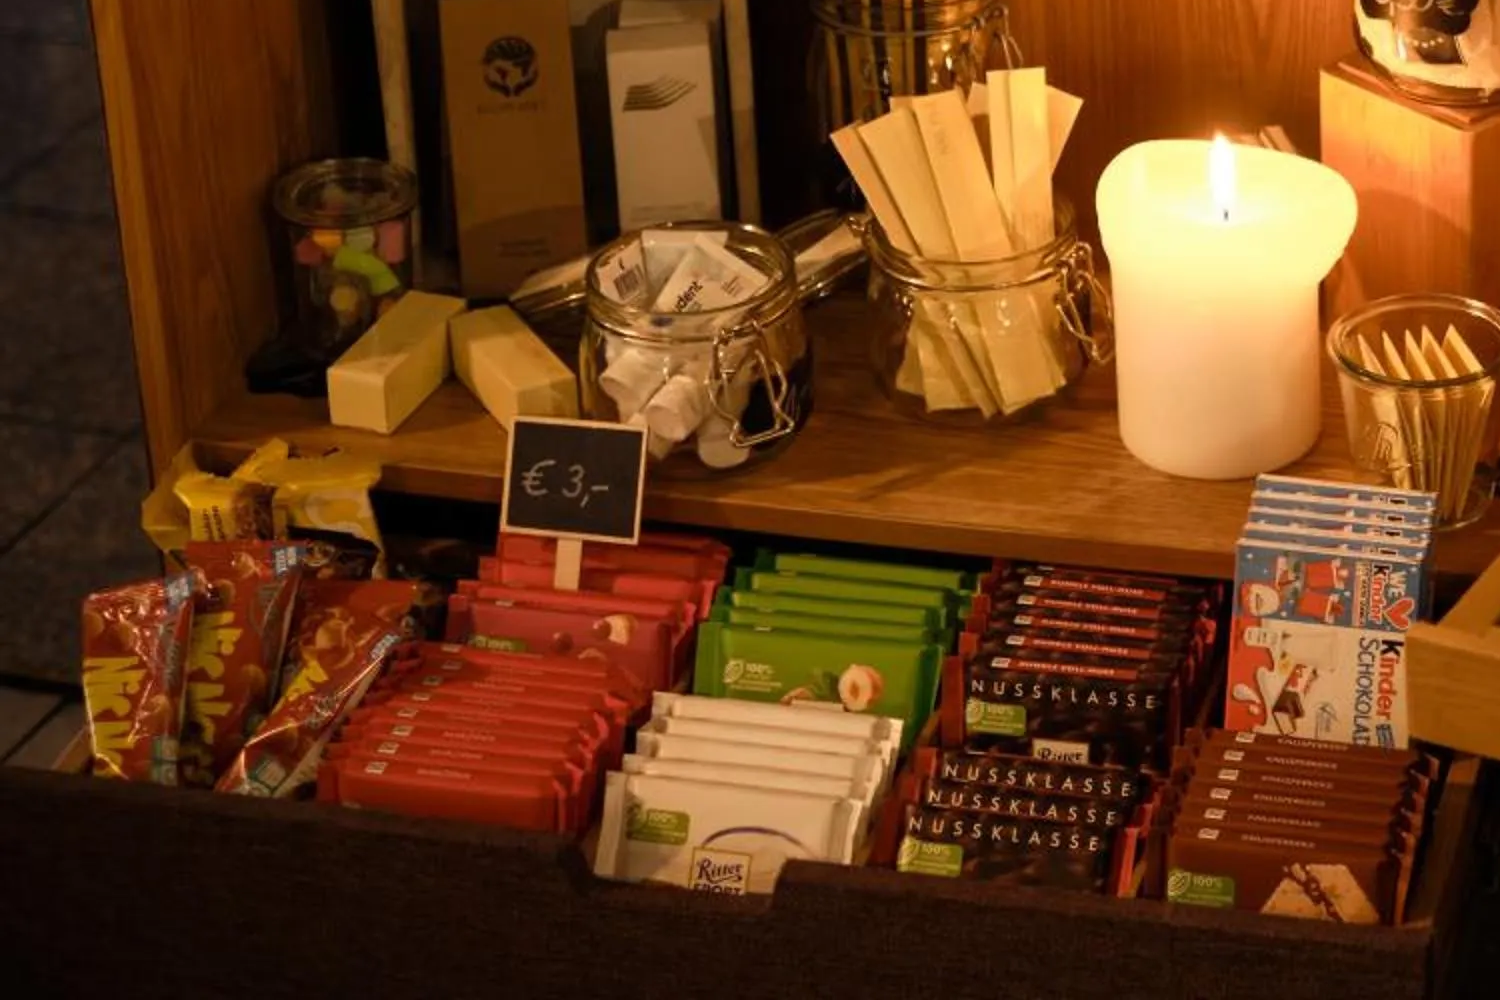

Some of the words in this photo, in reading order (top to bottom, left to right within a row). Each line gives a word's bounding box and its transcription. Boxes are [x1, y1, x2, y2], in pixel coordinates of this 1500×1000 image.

[970, 678, 1157, 711] NUSSKLASSE
[944, 764, 1134, 799] NUSSKLASSE
[927, 788, 1118, 828] NUSSKLASSE
[908, 815, 1101, 852] NUSSKLASSE
